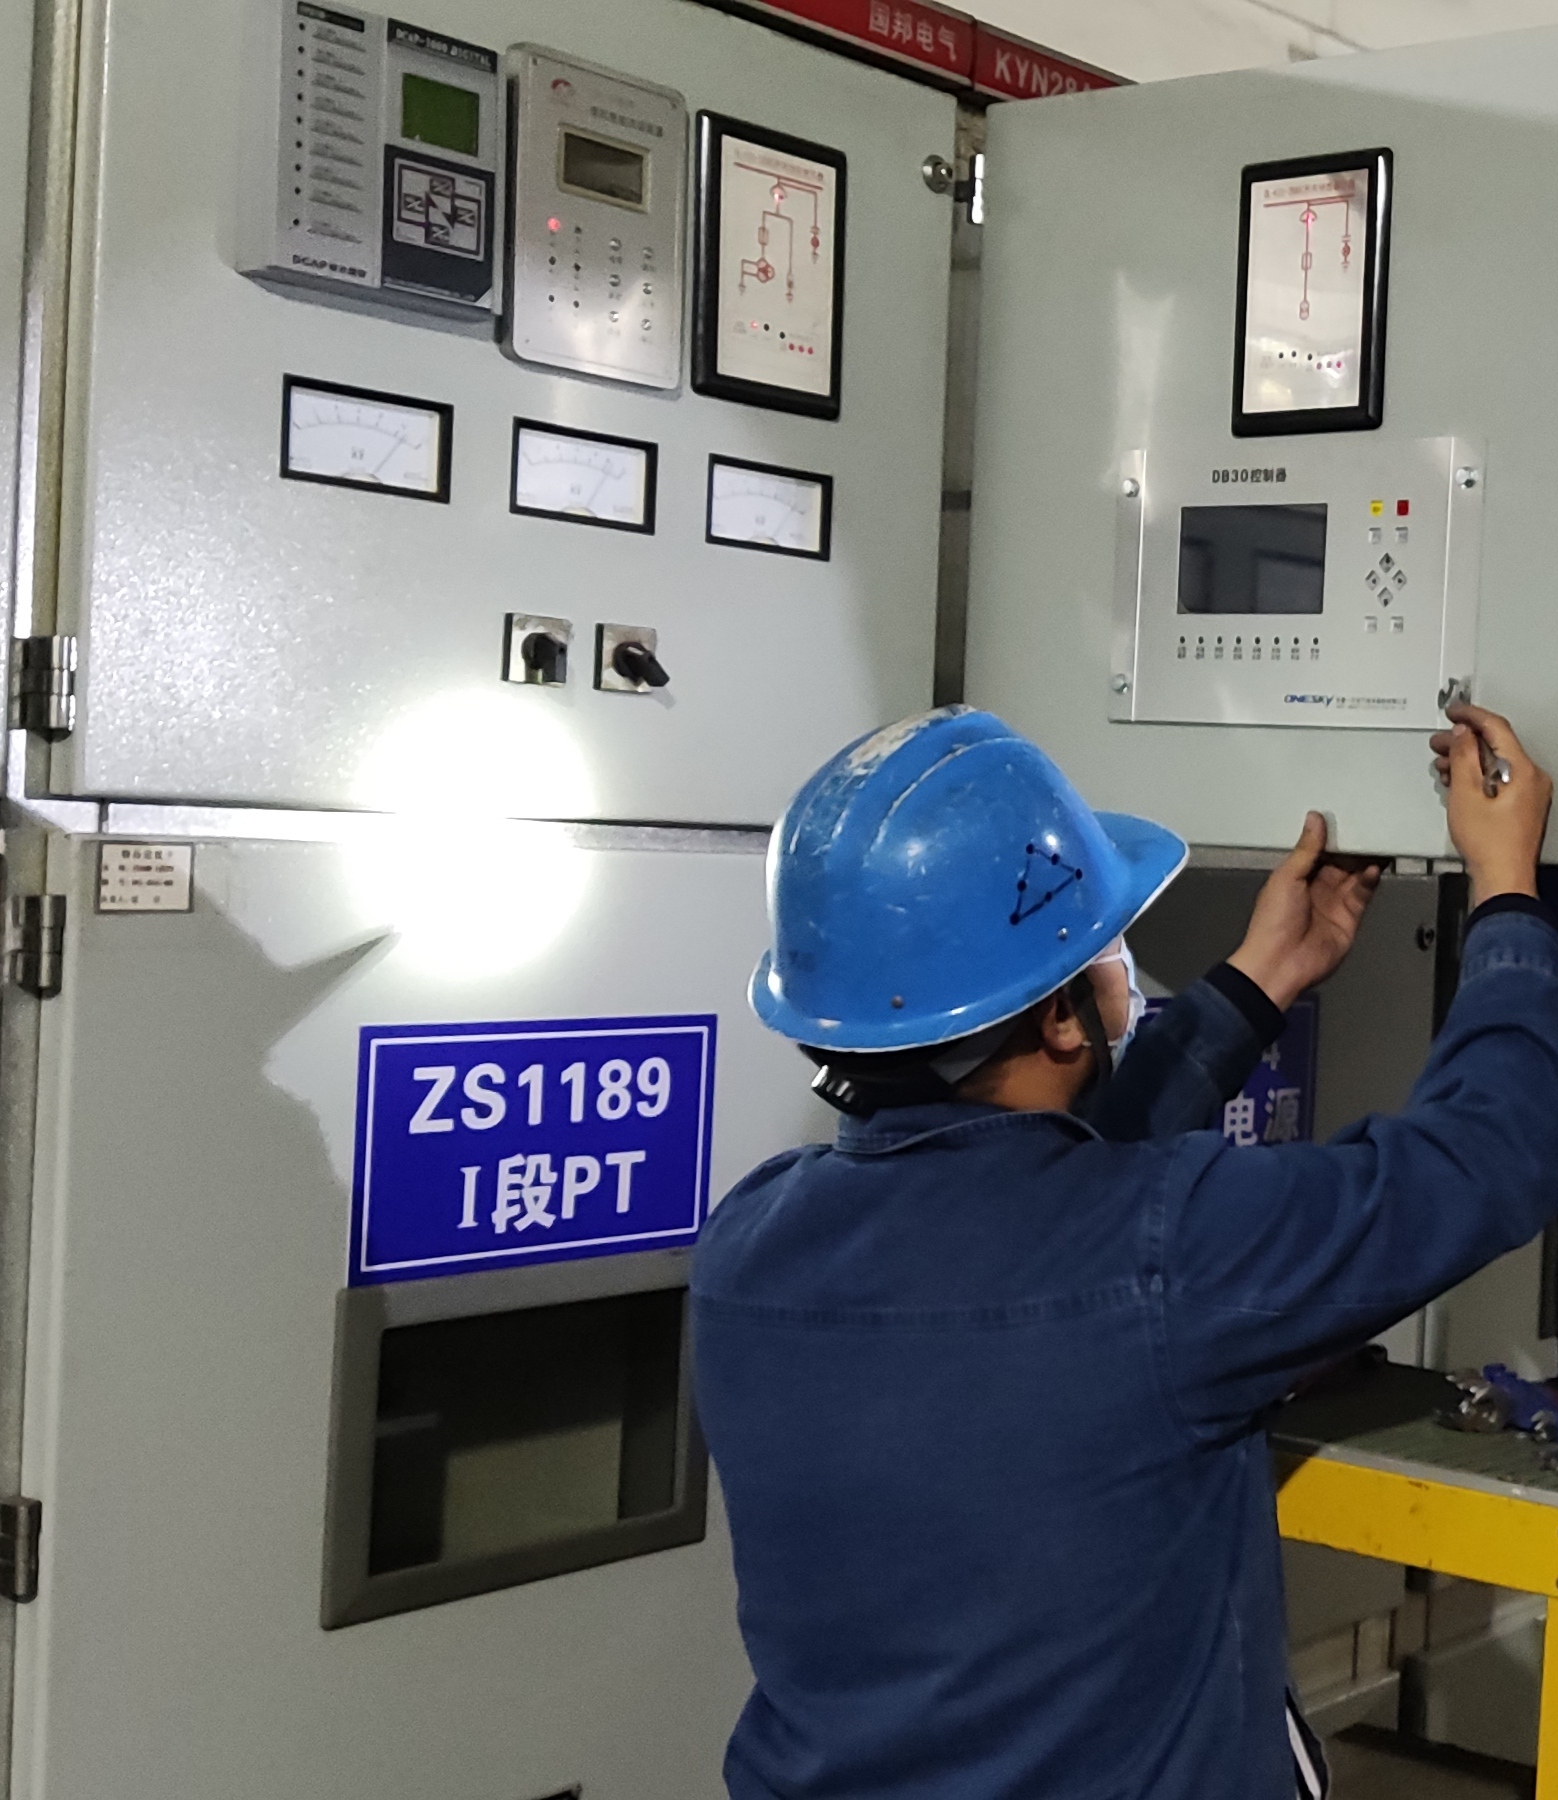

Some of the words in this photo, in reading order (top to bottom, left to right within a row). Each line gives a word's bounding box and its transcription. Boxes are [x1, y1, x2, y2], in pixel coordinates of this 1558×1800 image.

[868, 0, 957, 62] 国邦电气
[994, 48, 1091, 97] KYN28
[1212, 467, 1287, 484] DB30控制器
[409, 1057, 671, 1134] ZS1189
[1223, 1087, 1301, 1147] 电源
